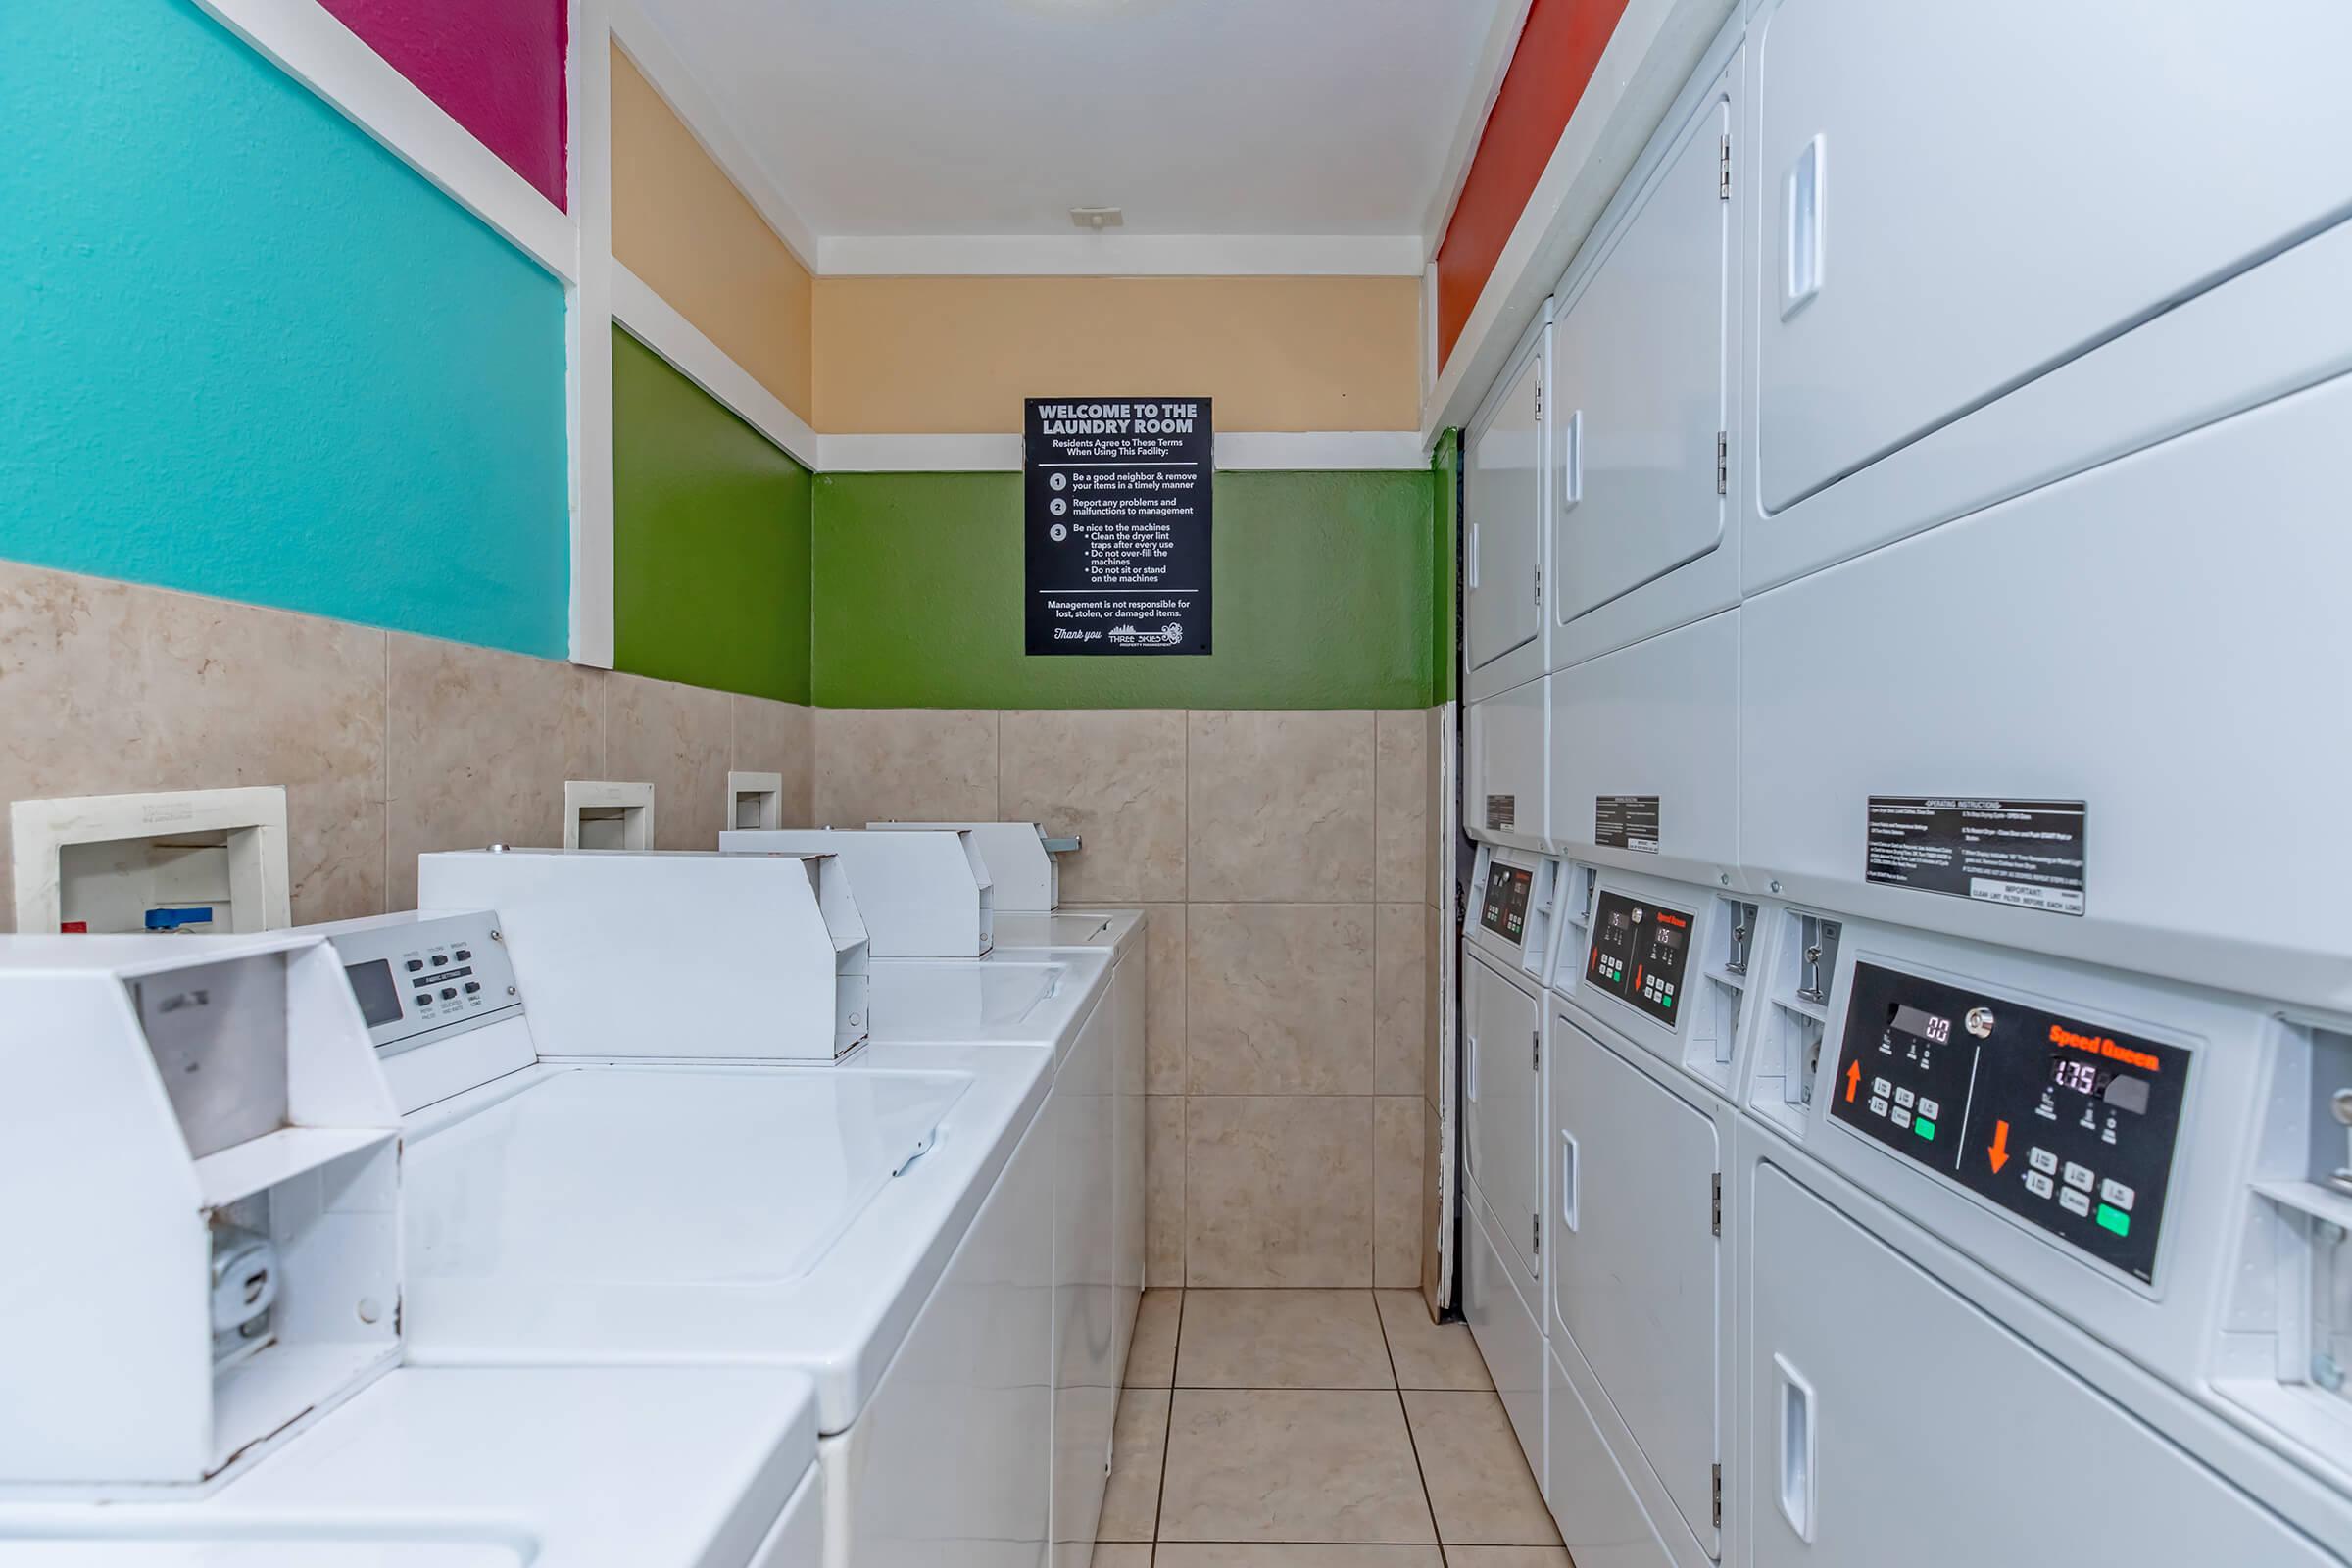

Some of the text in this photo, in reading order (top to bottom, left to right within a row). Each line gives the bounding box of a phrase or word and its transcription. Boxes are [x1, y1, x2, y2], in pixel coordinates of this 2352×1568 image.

[1038, 404, 1198, 419] WELCOME TO THE
[1043, 419, 1193, 434] LAUNDRY ROOM
[1095, 439, 1119, 449] Agree
[1067, 446, 1169, 457] When Using This Facility:
[1093, 473, 1115, 482] good
[1117, 472, 1154, 482] neighbor
[1073, 482, 1092, 491] your
[1135, 481, 1160, 490] timely
[1073, 499, 1102, 508] Report
[1119, 498, 1158, 507] problems
[1138, 508, 1194, 516] management
[1132, 532, 1154, 541] dryer
[1091, 542, 1111, 551] traps
[1048, 601, 1102, 610] Management
[1129, 600, 1176, 610] responsible
[1056, 610, 1073, 618] lost,
[1075, 610, 1102, 618] stolen,
[1115, 609, 1154, 618] damaged
[1054, 628, 1102, 642] Thank you
[1927, 1016, 1949, 1042] 00
[2049, 1024, 2159, 1071] Speed Queen
[2056, 1060, 2095, 1095] 1.75
